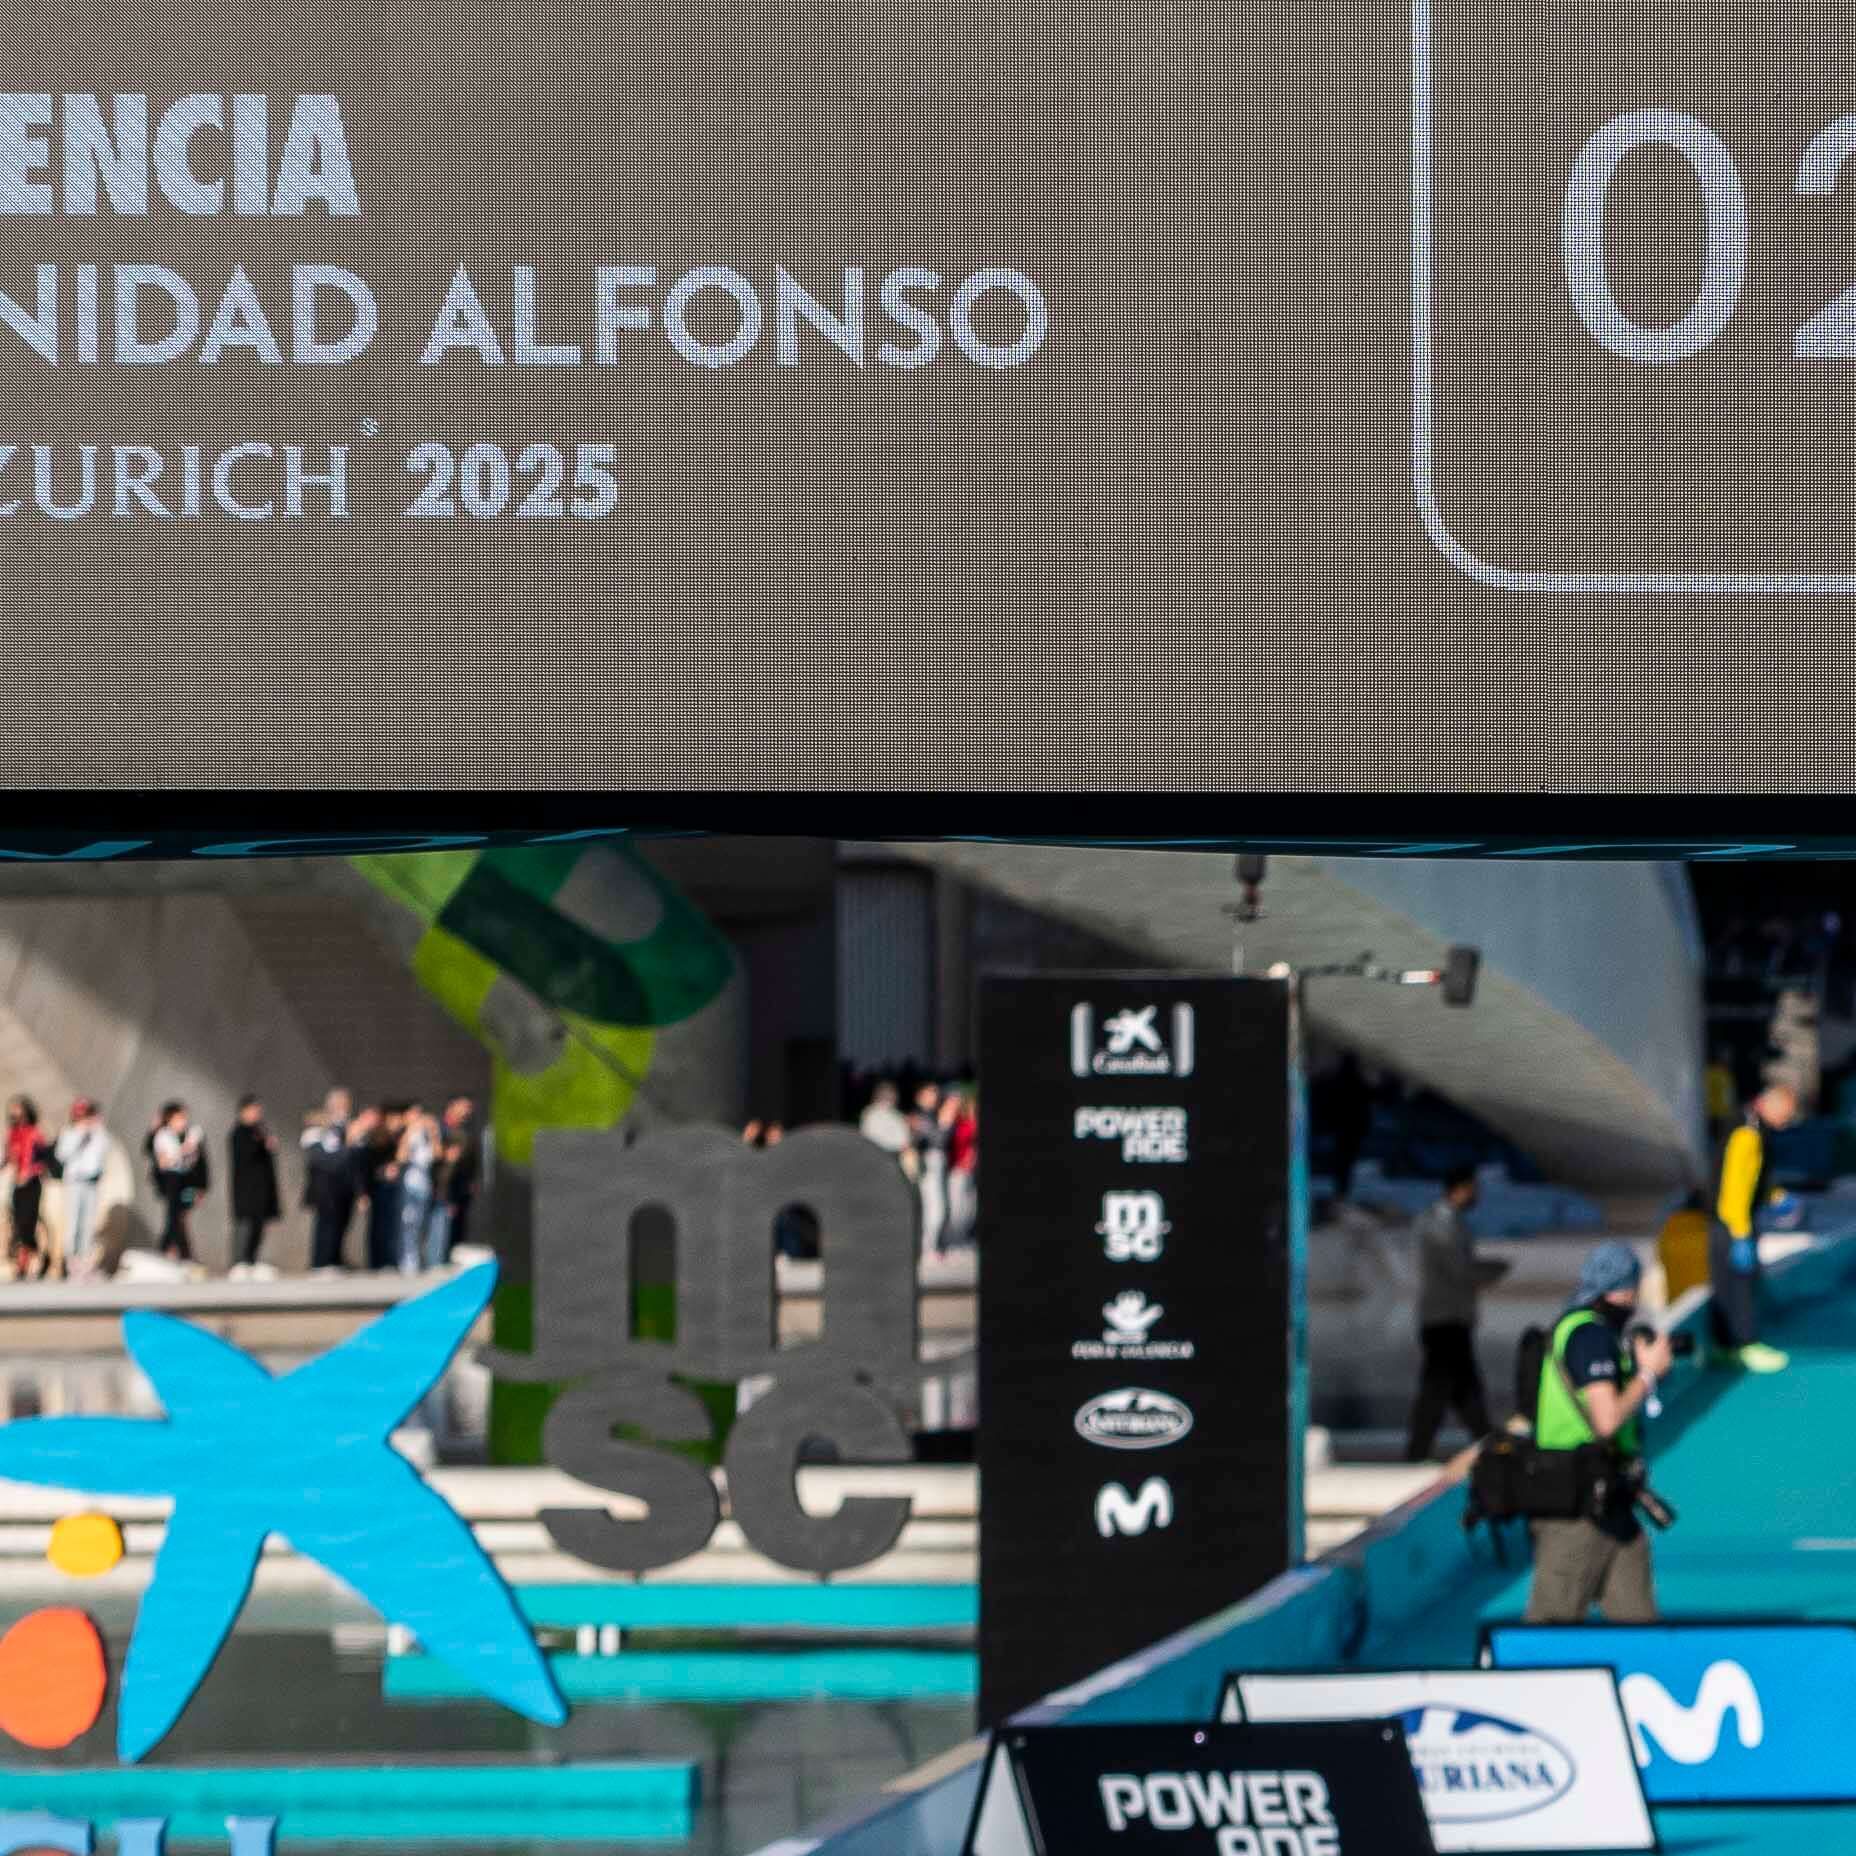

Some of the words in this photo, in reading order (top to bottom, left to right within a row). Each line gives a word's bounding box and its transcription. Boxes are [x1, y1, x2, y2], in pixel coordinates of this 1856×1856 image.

[420, 262, 1049, 369] ALFONSO
[404, 443, 620, 522] 2025
[1099, 1771, 1335, 1832] POWER
